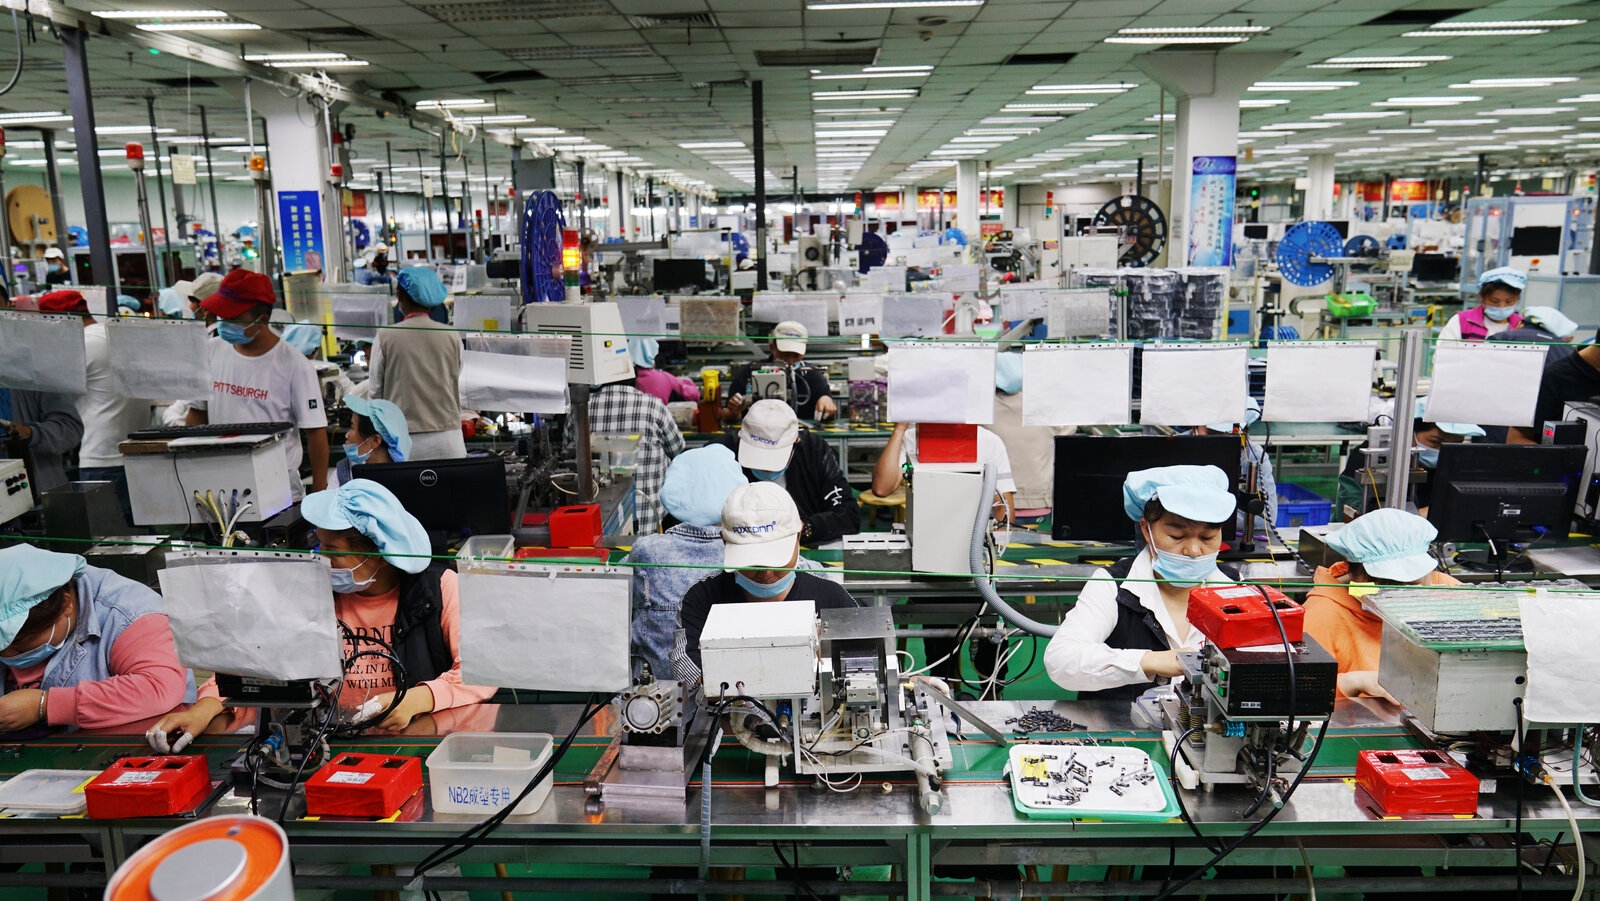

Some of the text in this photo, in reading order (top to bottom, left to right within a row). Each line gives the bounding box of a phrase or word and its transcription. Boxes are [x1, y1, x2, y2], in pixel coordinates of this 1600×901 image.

[213, 381, 268, 400] PITTSBURGH
[366, 664, 378, 674] IN
[346, 679, 378, 689] WITH
